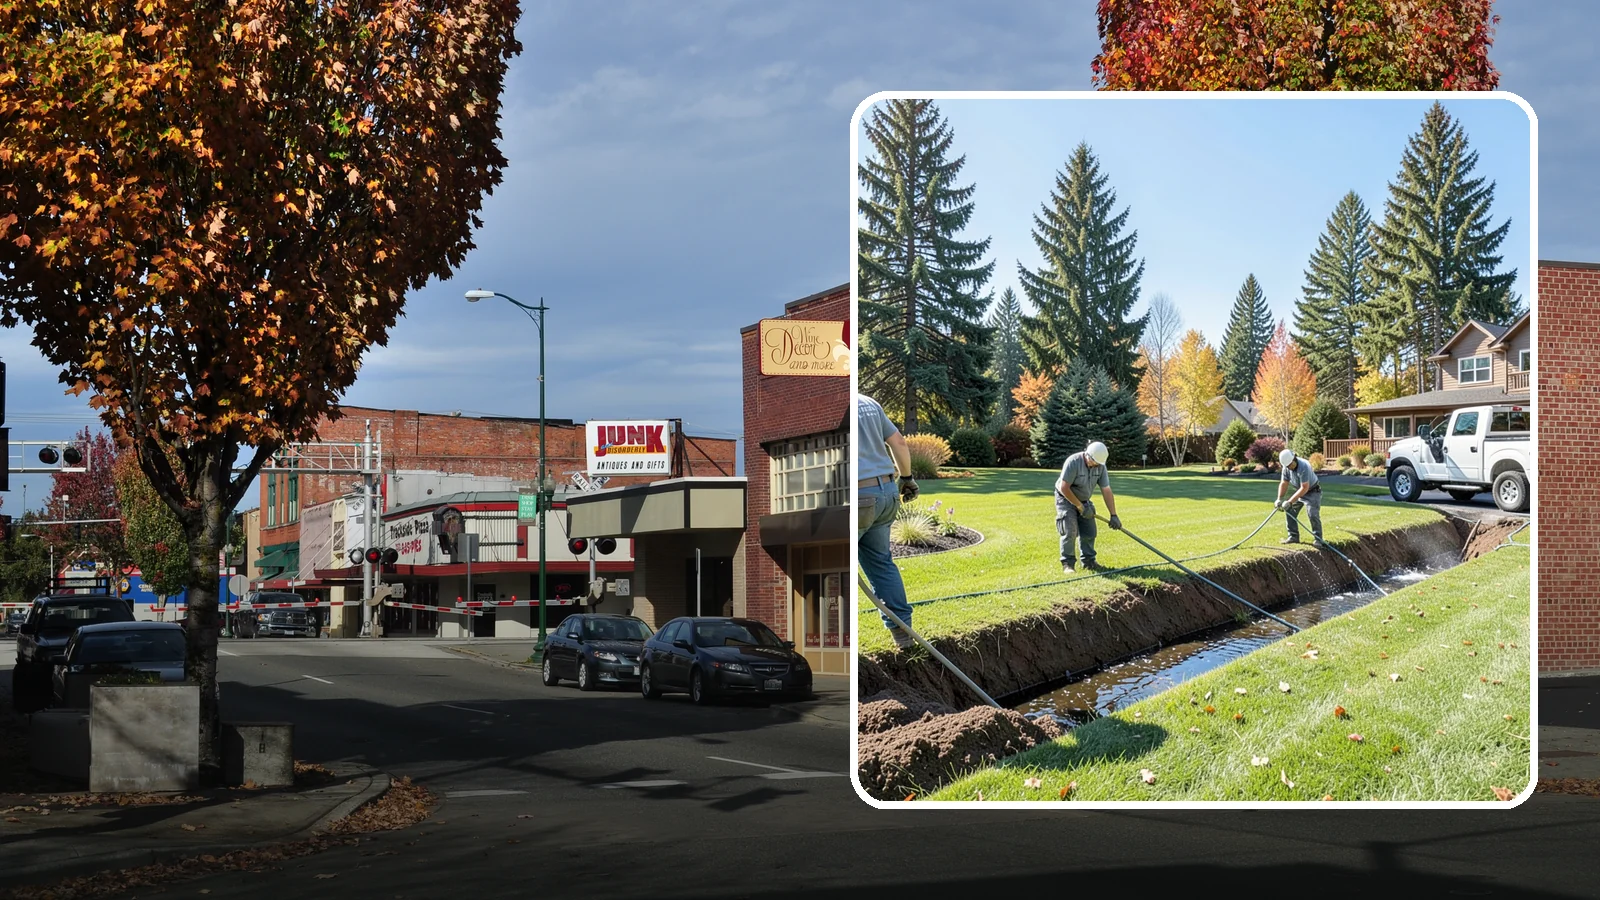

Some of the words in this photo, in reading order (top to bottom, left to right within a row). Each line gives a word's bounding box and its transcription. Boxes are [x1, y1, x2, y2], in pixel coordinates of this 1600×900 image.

[596, 426, 665, 457] JUNK
[607, 446, 645, 454] DISORDERLY
[597, 461, 628, 470] ANTIQUES
[631, 461, 644, 469] AND
[647, 461, 665, 469] GIFTS
[390, 521, 413, 539] Trackside
[415, 519, 428, 534] Pizza
